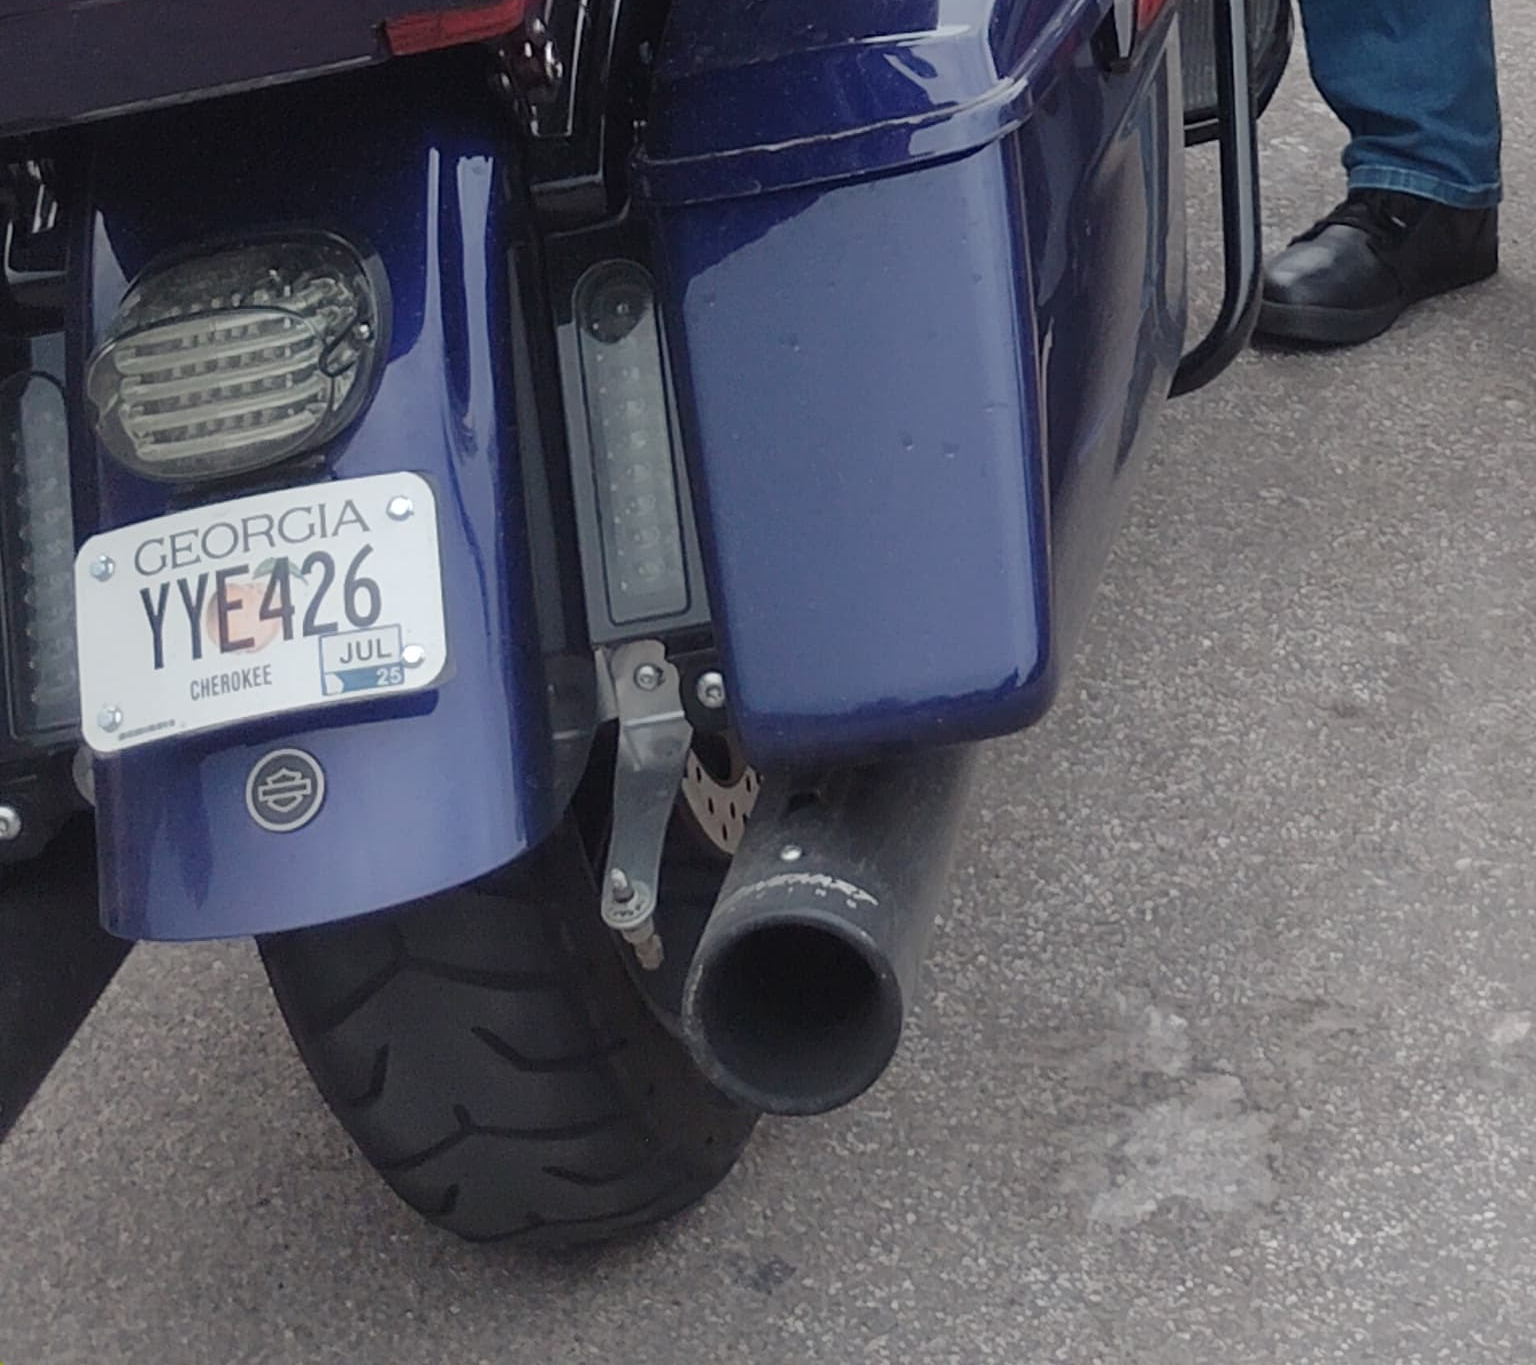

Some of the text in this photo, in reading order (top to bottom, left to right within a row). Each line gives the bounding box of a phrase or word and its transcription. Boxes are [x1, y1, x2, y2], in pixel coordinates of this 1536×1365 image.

[134, 499, 370, 577] GEORGIA
[140, 543, 383, 671] YYE426
[338, 637, 393, 665] JUL
[189, 664, 273, 702] CHEROKEE
[376, 667, 402, 686] 25
